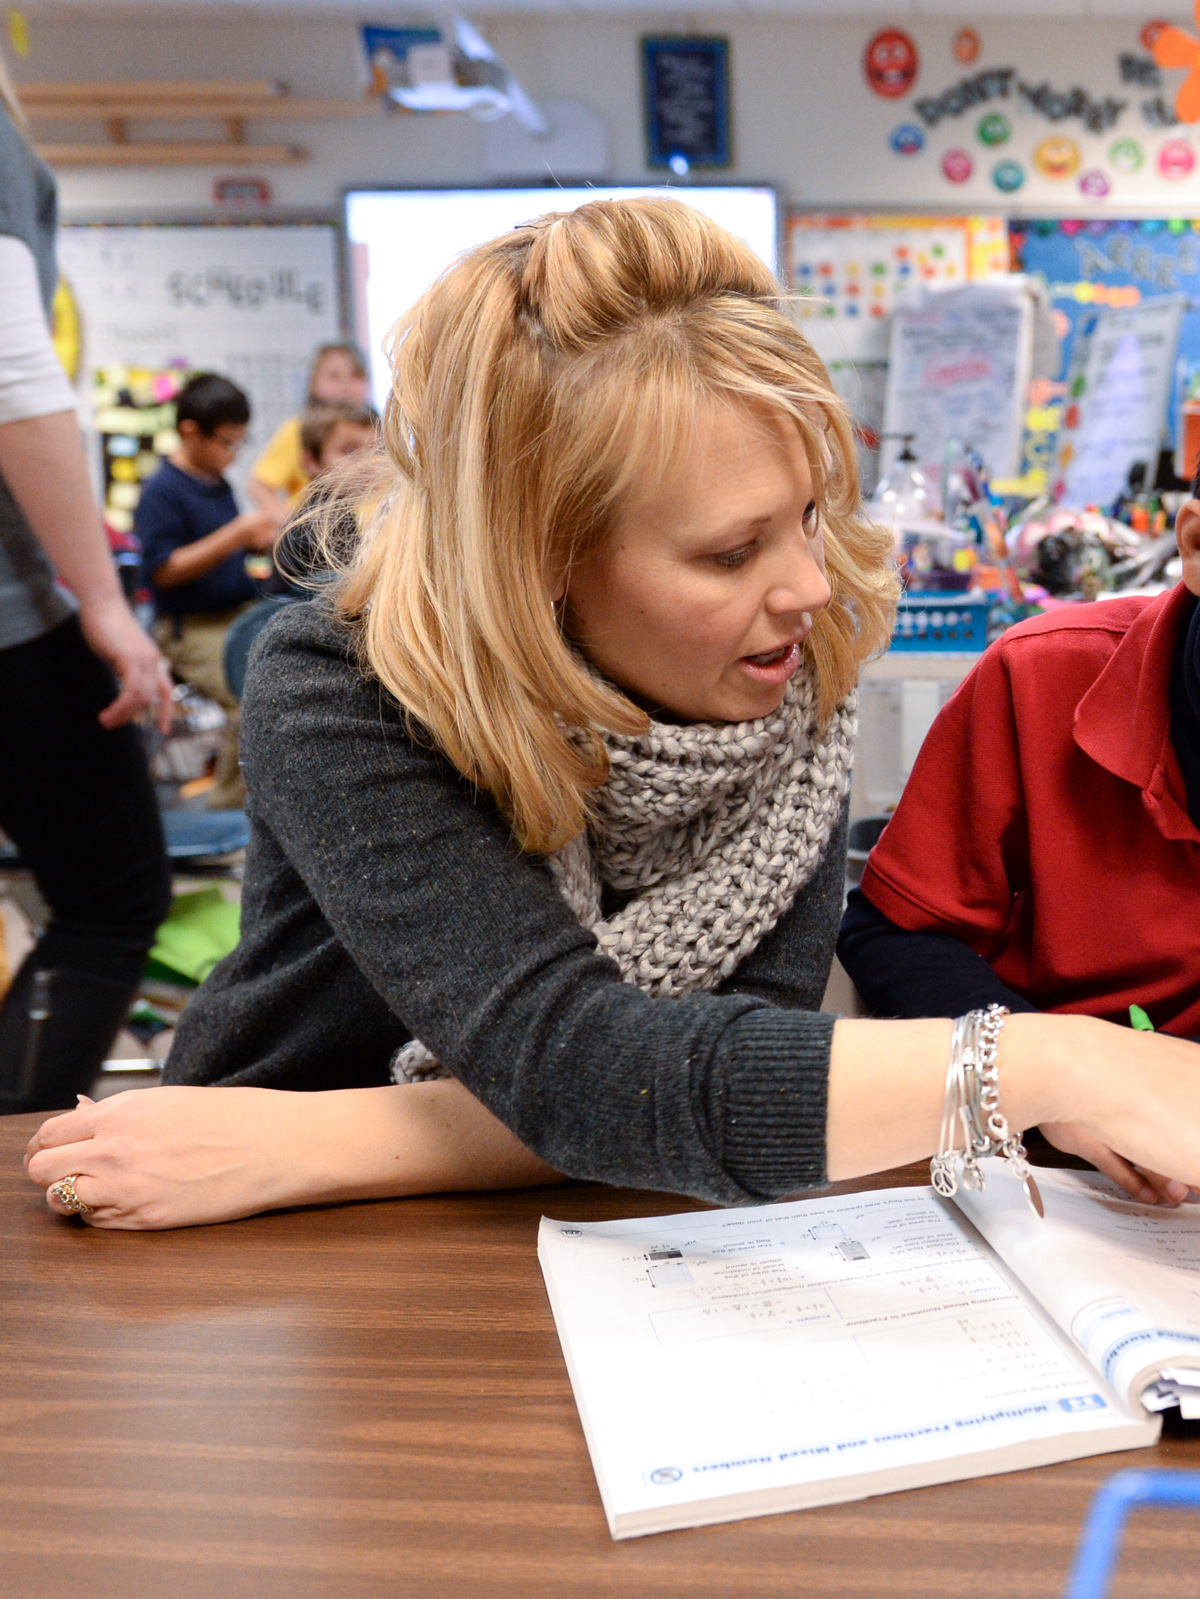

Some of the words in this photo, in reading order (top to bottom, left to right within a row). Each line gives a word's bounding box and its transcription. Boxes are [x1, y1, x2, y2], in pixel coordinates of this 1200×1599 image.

[1157, 1331, 1200, 1342] Mixed
[953, 1404, 1049, 1429] Multiplying
[872, 1424, 951, 1444] Fractions
[777, 1446, 831, 1461] Mixed
[835, 1439, 869, 1451] and
[691, 1455, 773, 1474] Numbers
